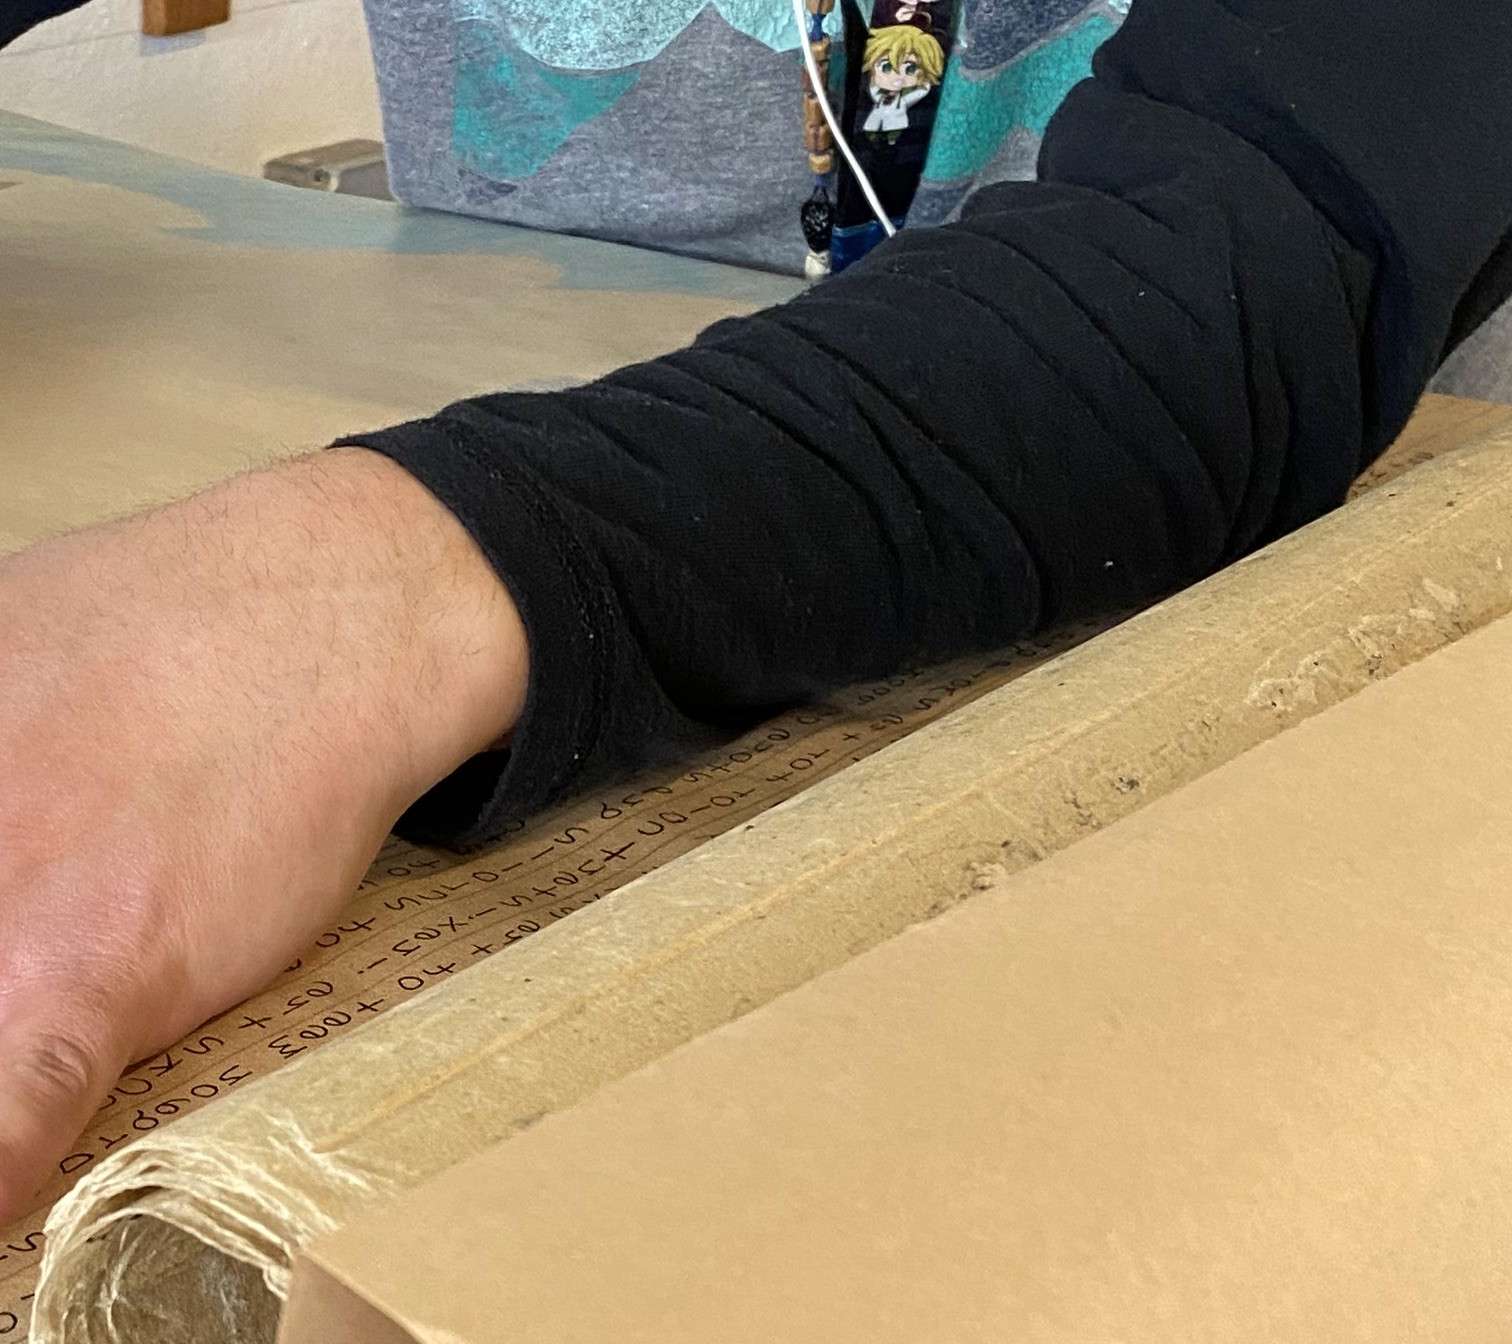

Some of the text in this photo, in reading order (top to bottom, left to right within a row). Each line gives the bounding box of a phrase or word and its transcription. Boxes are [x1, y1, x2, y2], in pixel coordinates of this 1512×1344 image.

[383, 826, 590, 911] scrolls
[237, 980, 334, 1029] the
[58, 1064, 253, 1175] Dragon
[267, 998, 385, 1060] meet
[397, 962, 456, 991] of
